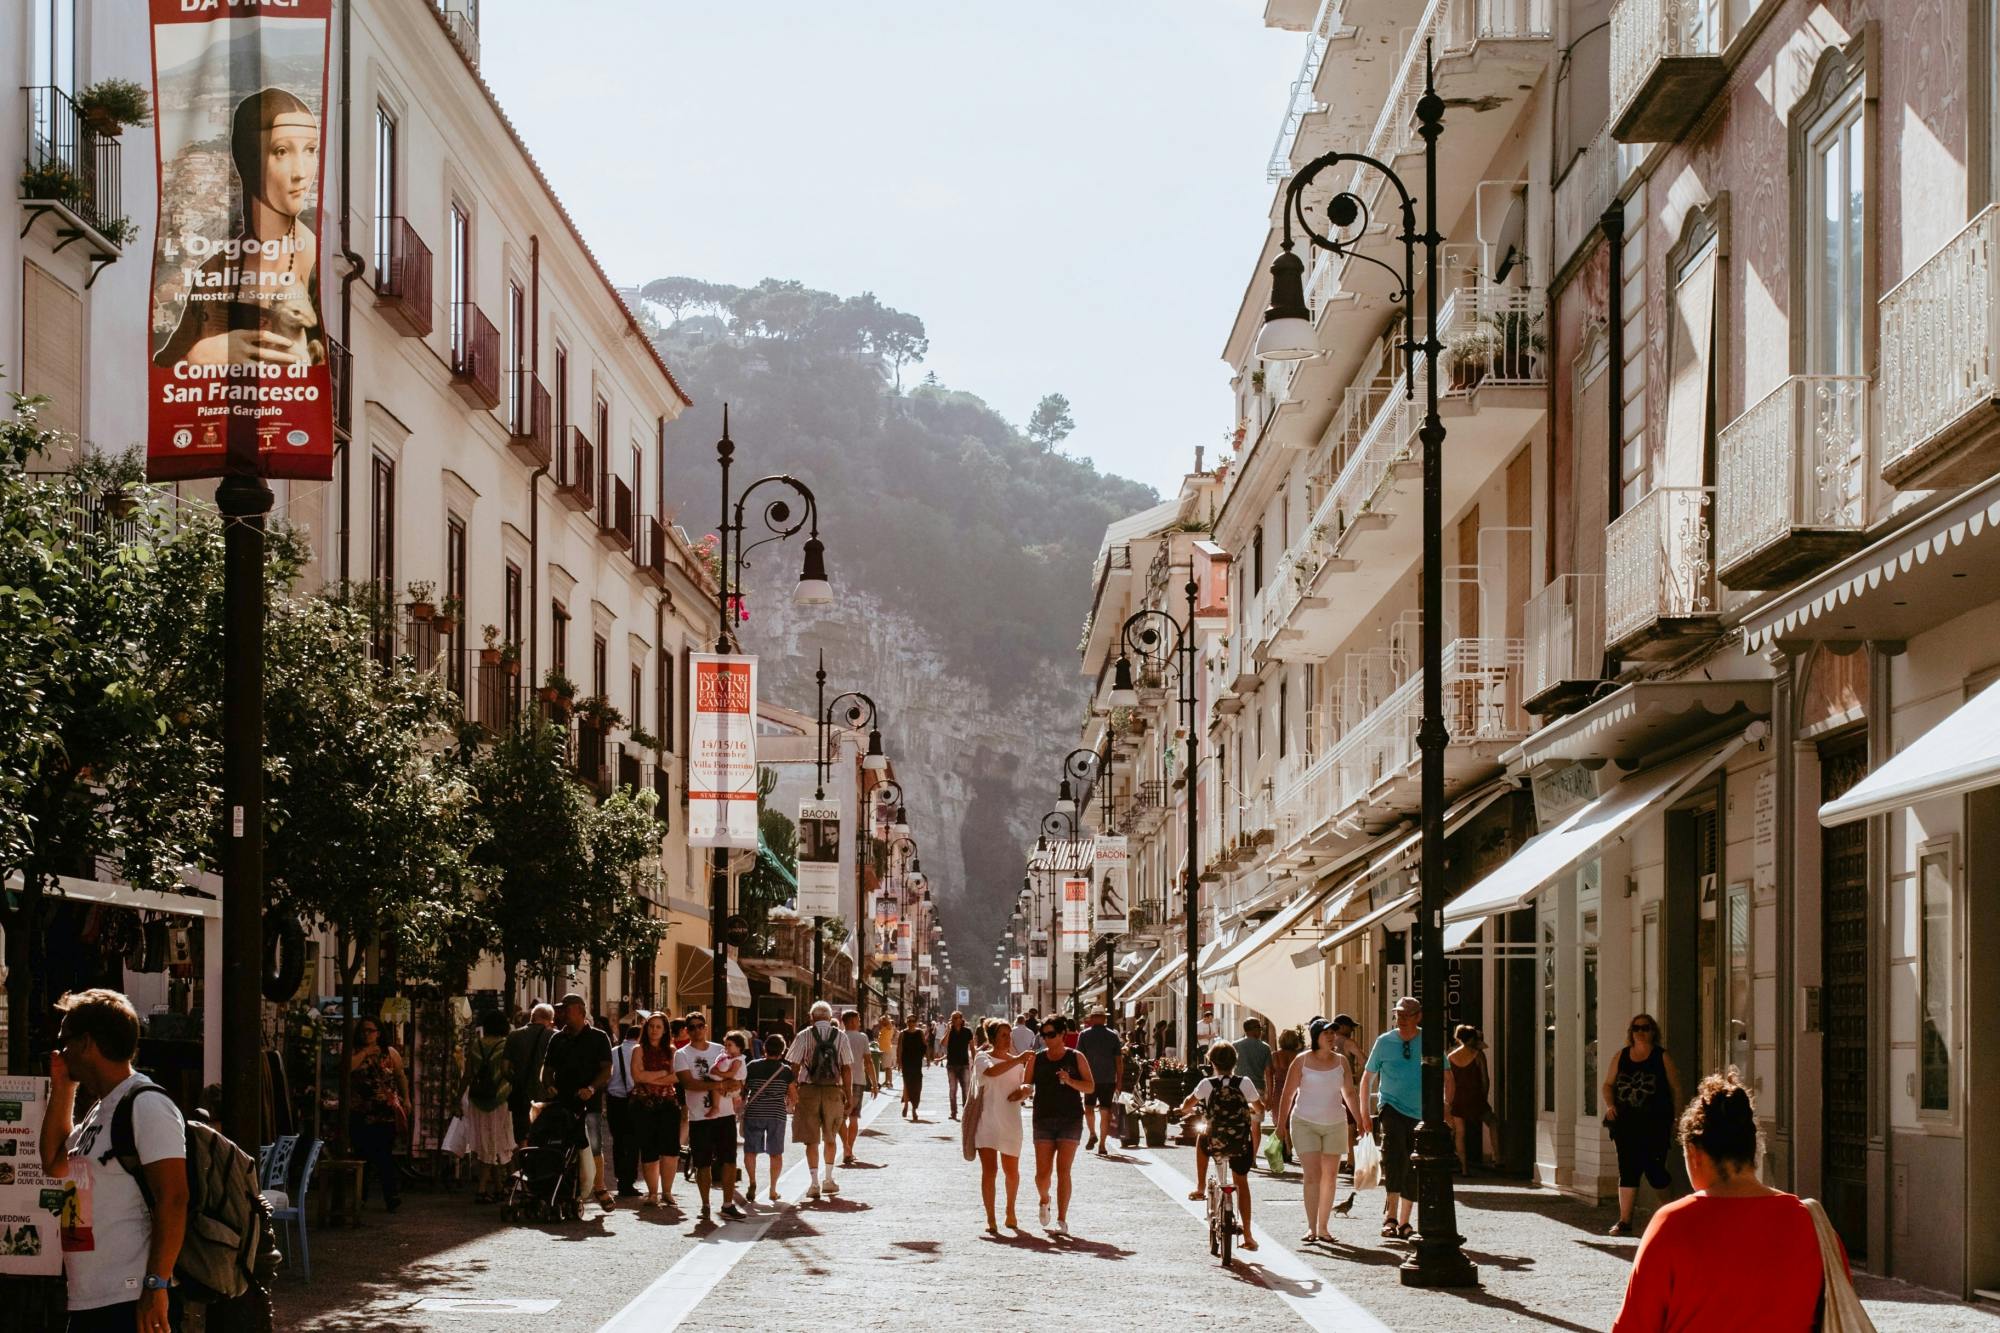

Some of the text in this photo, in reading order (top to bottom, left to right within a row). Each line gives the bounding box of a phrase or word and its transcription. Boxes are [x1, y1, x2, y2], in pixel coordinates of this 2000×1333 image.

[164, 235, 306, 261] L'Orgoglio
[181, 267, 296, 288] Italiano
[174, 292, 186, 302] In
[190, 291, 236, 302] mostra
[237, 291, 245, 300] a
[173, 360, 310, 380] Convento di
[162, 382, 319, 404] San Francesco
[197, 404, 283, 419] Piazza Gargiulo
[717, 681, 748, 693] VINI
[698, 698, 748, 709] CAMPANI
[702, 740, 747, 750] 14/15/16
[693, 760, 712, 769] Villa
[801, 809, 838, 819] BACON
[1096, 851, 1126, 859] BACON
[18, 1162, 42, 1170] LIMONC
[18, 1170, 41, 1179] CHEESE,
[17, 1178, 34, 1186] OLIVE
